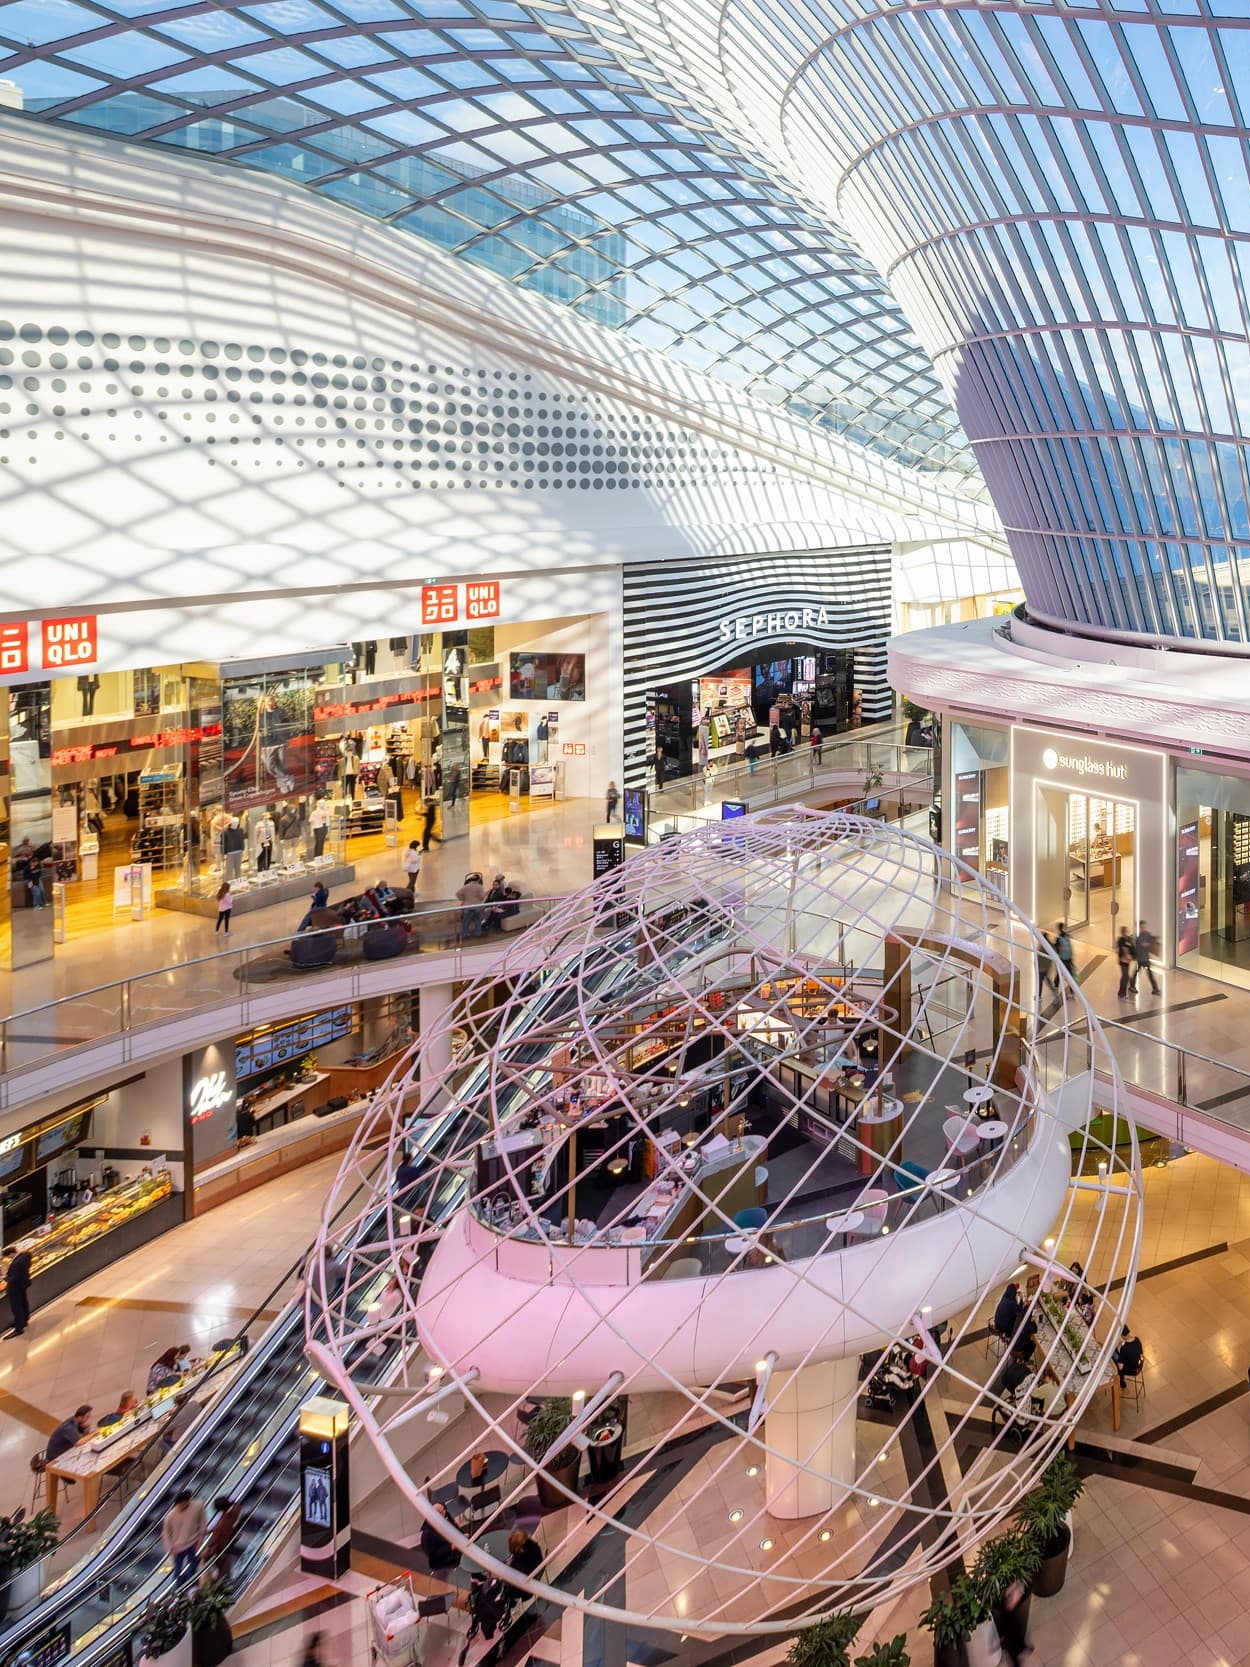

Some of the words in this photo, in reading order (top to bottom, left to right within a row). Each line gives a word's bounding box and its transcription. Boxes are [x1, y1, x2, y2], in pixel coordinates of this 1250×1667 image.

[469, 585, 495, 601] UNI
[469, 600, 497, 617] QLO
[47, 622, 88, 642] UNI
[719, 606, 829, 641] SEPHORA
[47, 641, 92, 664] QLO
[1059, 755, 1105, 775] sunglass
[1106, 761, 1126, 780] hut
[612, 841, 620, 849] G
